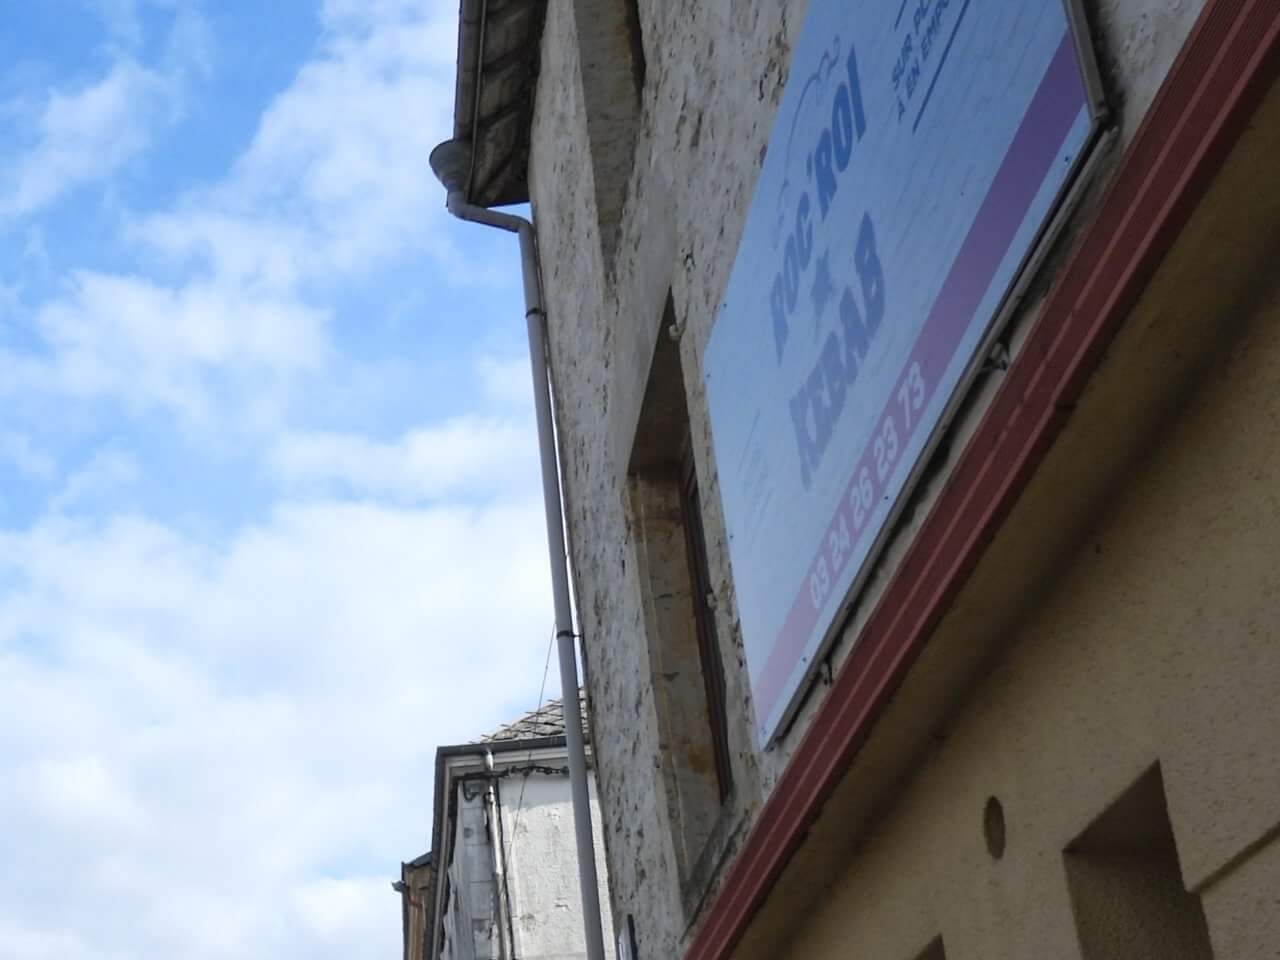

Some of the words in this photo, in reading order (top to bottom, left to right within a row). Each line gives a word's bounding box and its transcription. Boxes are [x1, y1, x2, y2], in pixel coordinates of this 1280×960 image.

[892, 32, 914, 92] SUR
[789, 210, 886, 491] KEBAB
[810, 554, 828, 608] 03
[829, 515, 851, 571] 24
[851, 466, 874, 523] 26
[874, 418, 899, 483] 23
[898, 360, 926, 430] 73
